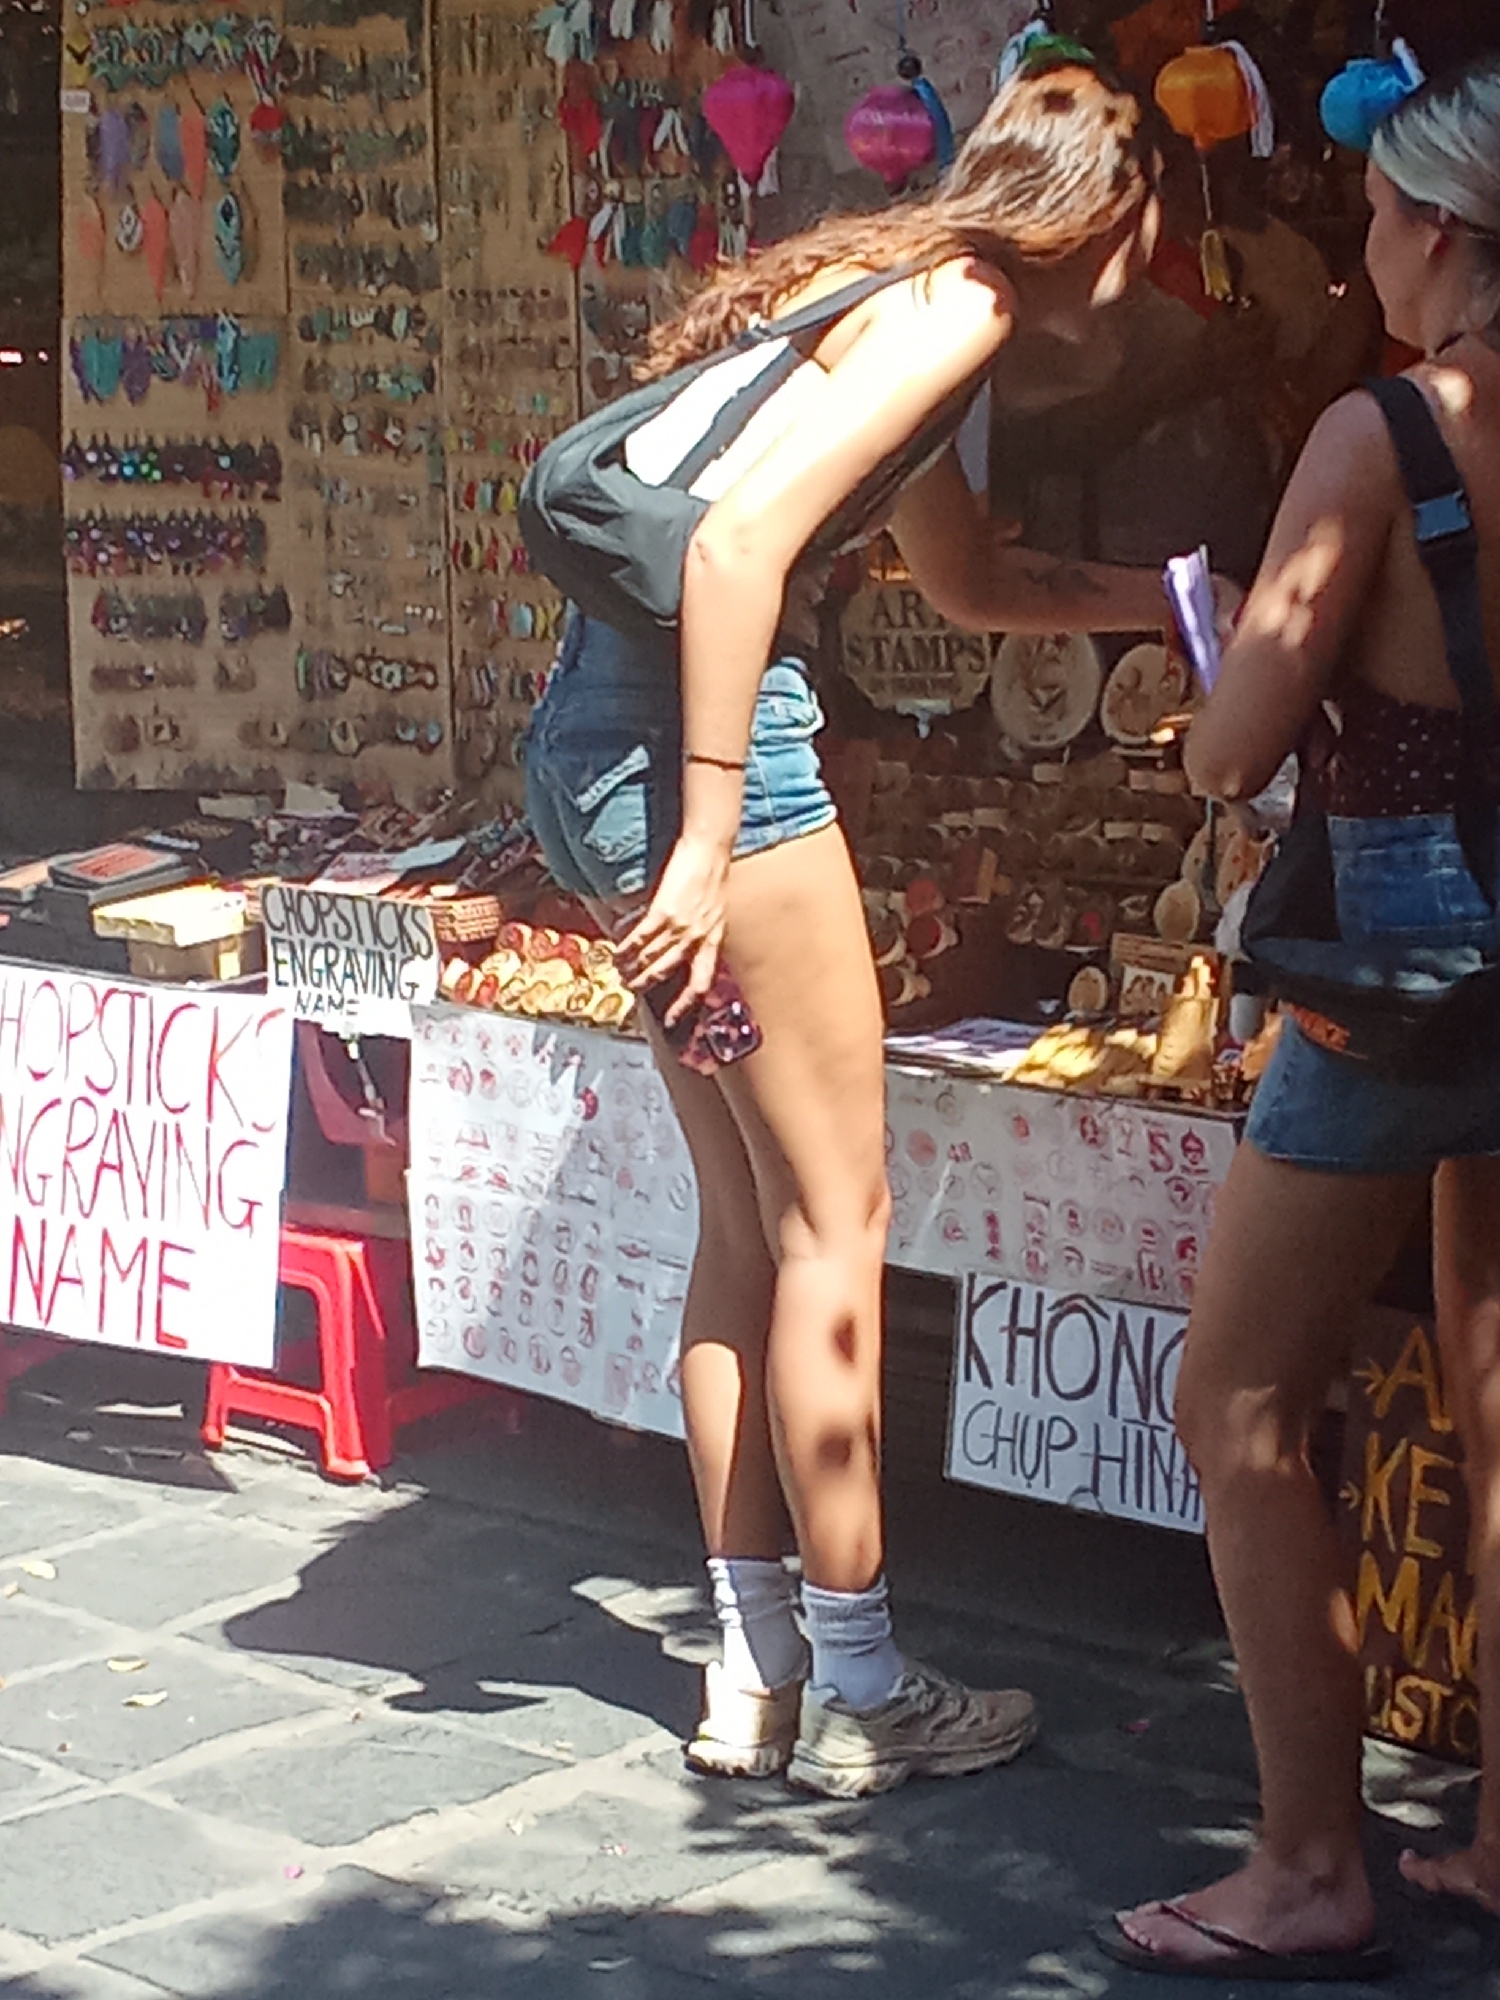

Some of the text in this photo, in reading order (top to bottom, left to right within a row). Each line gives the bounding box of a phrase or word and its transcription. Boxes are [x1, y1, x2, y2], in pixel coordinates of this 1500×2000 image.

[848, 631, 986, 674] STAMPS
[871, 589, 946, 629] AR
[262, 884, 433, 961] CHOPSTICKS
[271, 936, 419, 1000] ENGRAVING
[294, 990, 360, 1016] NAME
[0, 978, 286, 1133] HOPSTICKS
[0, 1093, 263, 1238] NGRAVING
[8, 1214, 197, 1351] NAME
[1374, 1326, 1453, 1434] A
[1362, 1431, 1475, 1578] KE
